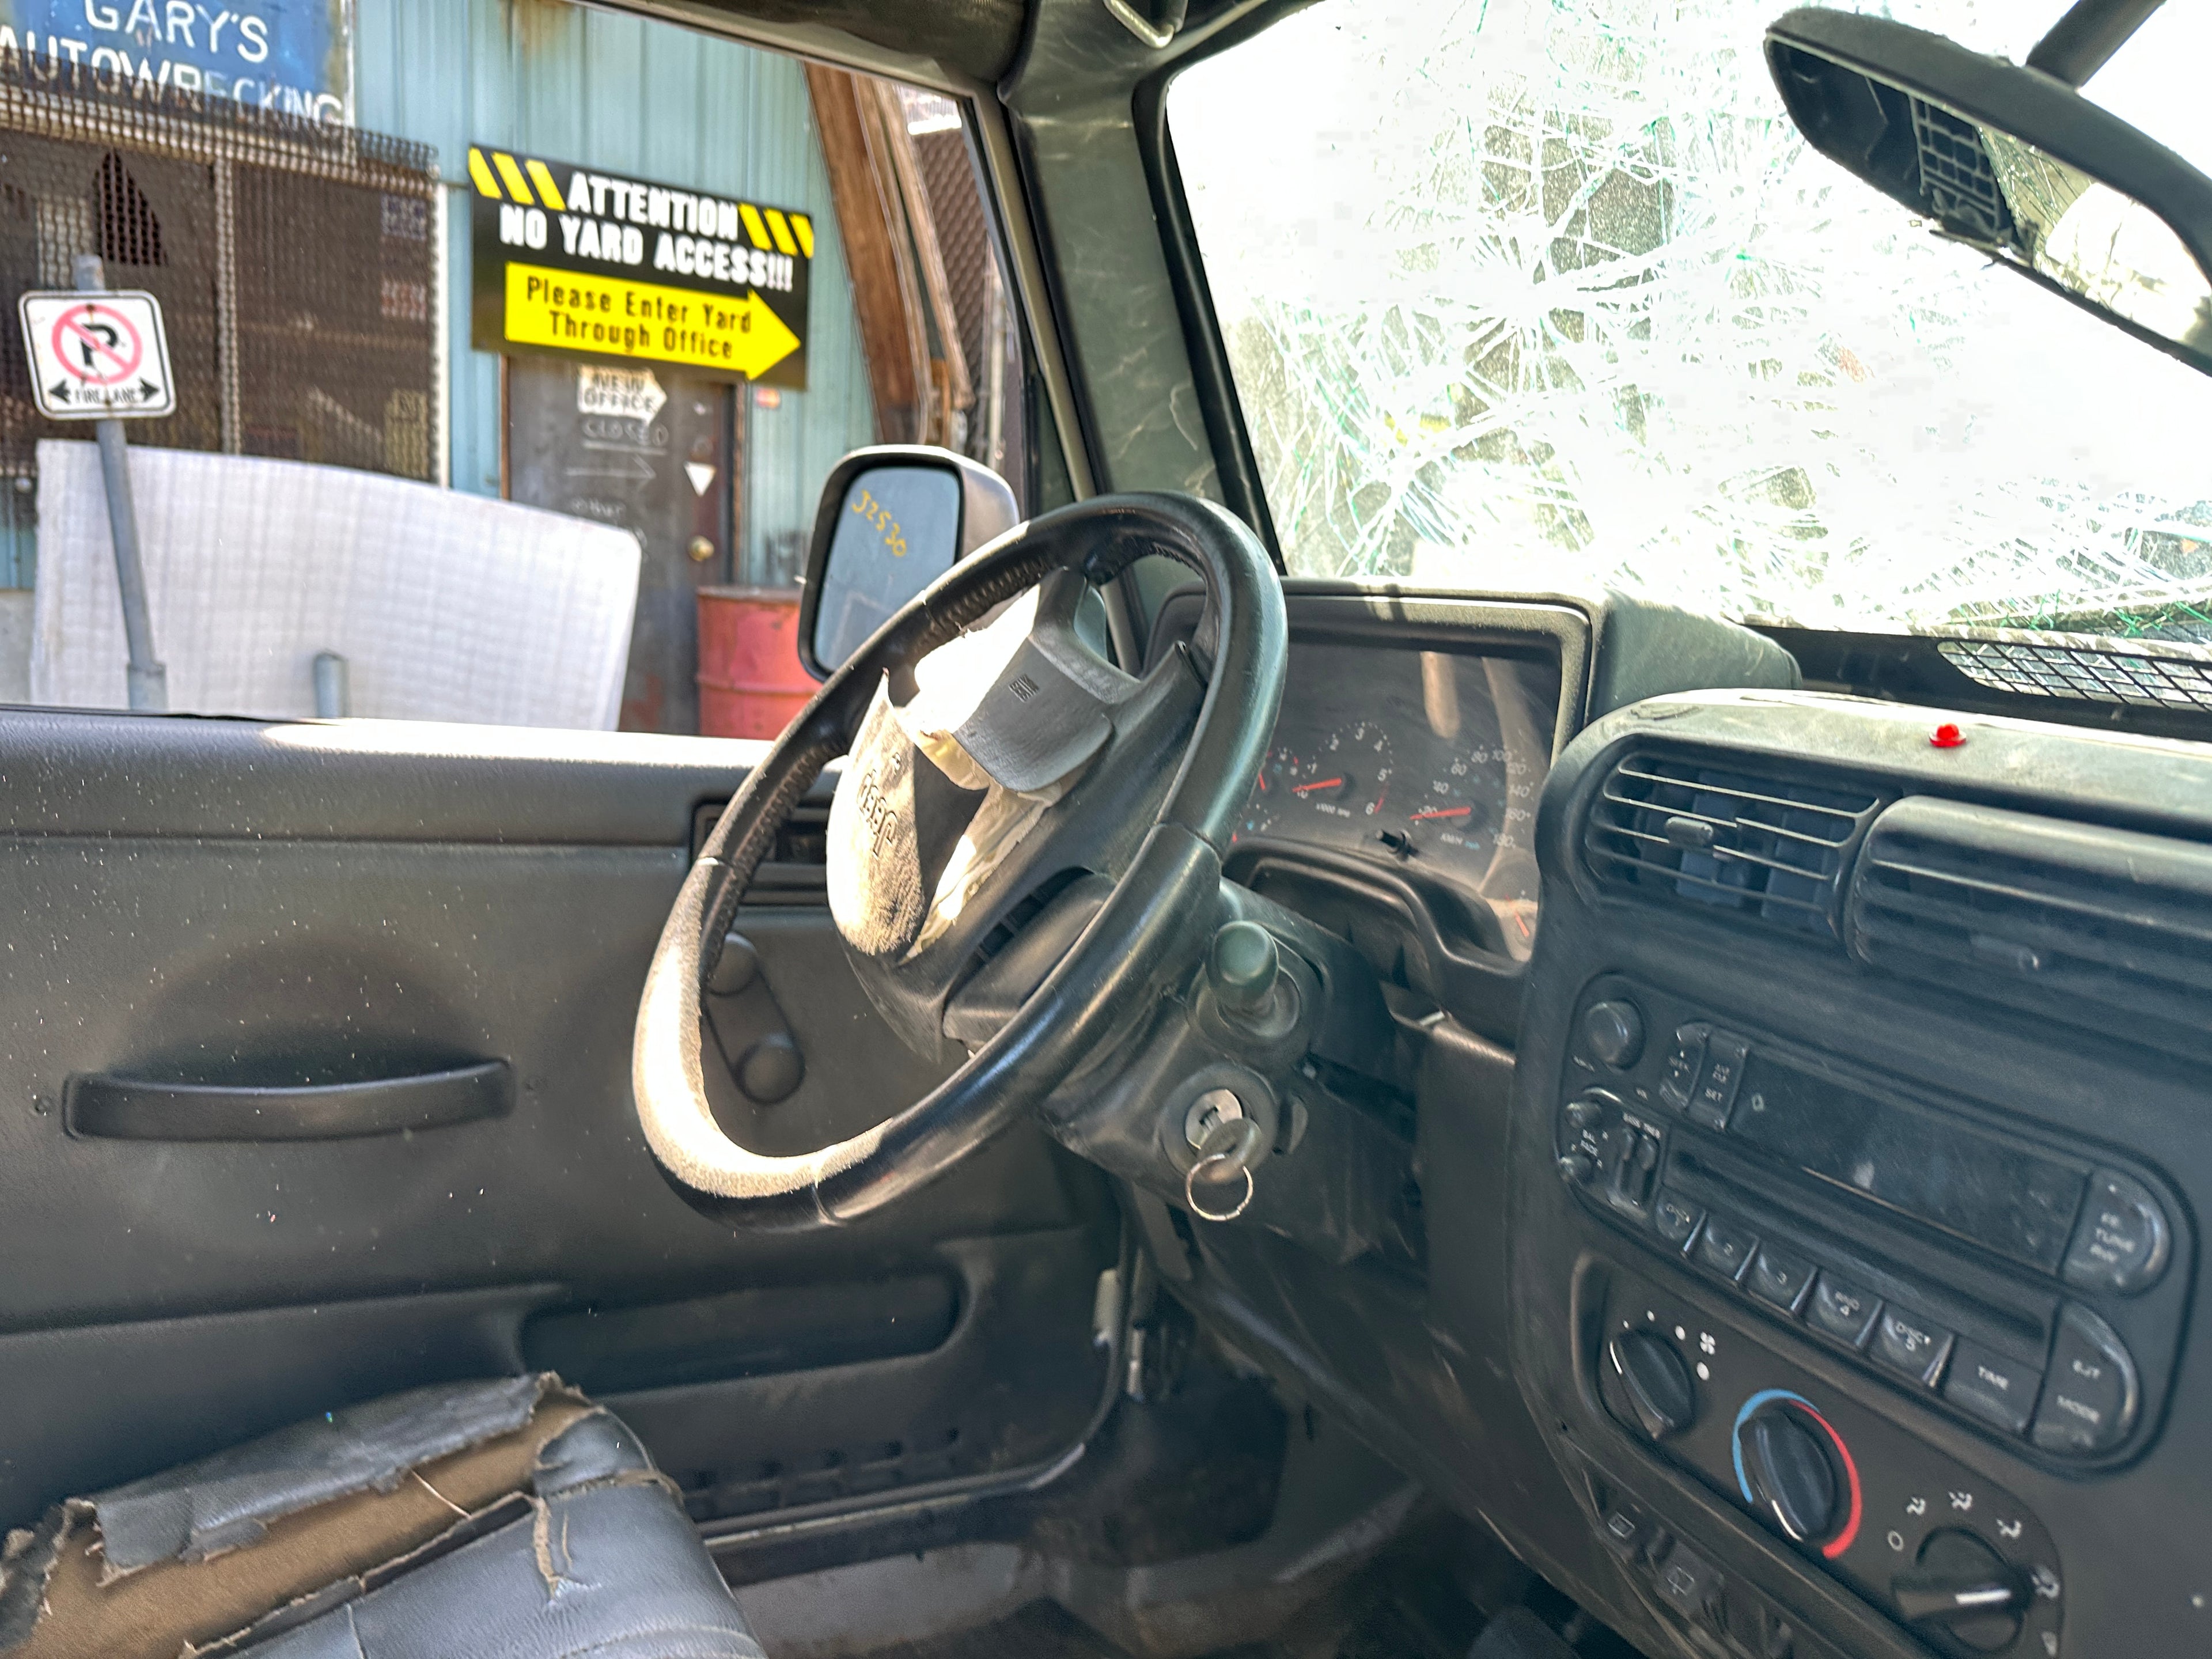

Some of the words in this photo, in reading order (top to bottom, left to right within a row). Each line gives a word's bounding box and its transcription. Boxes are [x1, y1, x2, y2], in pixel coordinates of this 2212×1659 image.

[85, 0, 268, 63] GARY'S
[567, 172, 738, 241] ATTENTION
[500, 203, 547, 249] NO
[559, 214, 643, 265] YARD
[654, 232, 793, 292] ACCESS!!!
[528, 276, 611, 313] Please
[626, 291, 689, 320] Enter
[703, 304, 751, 334] Yard
[550, 310, 650, 355] Through
[664, 327, 733, 359] Office
